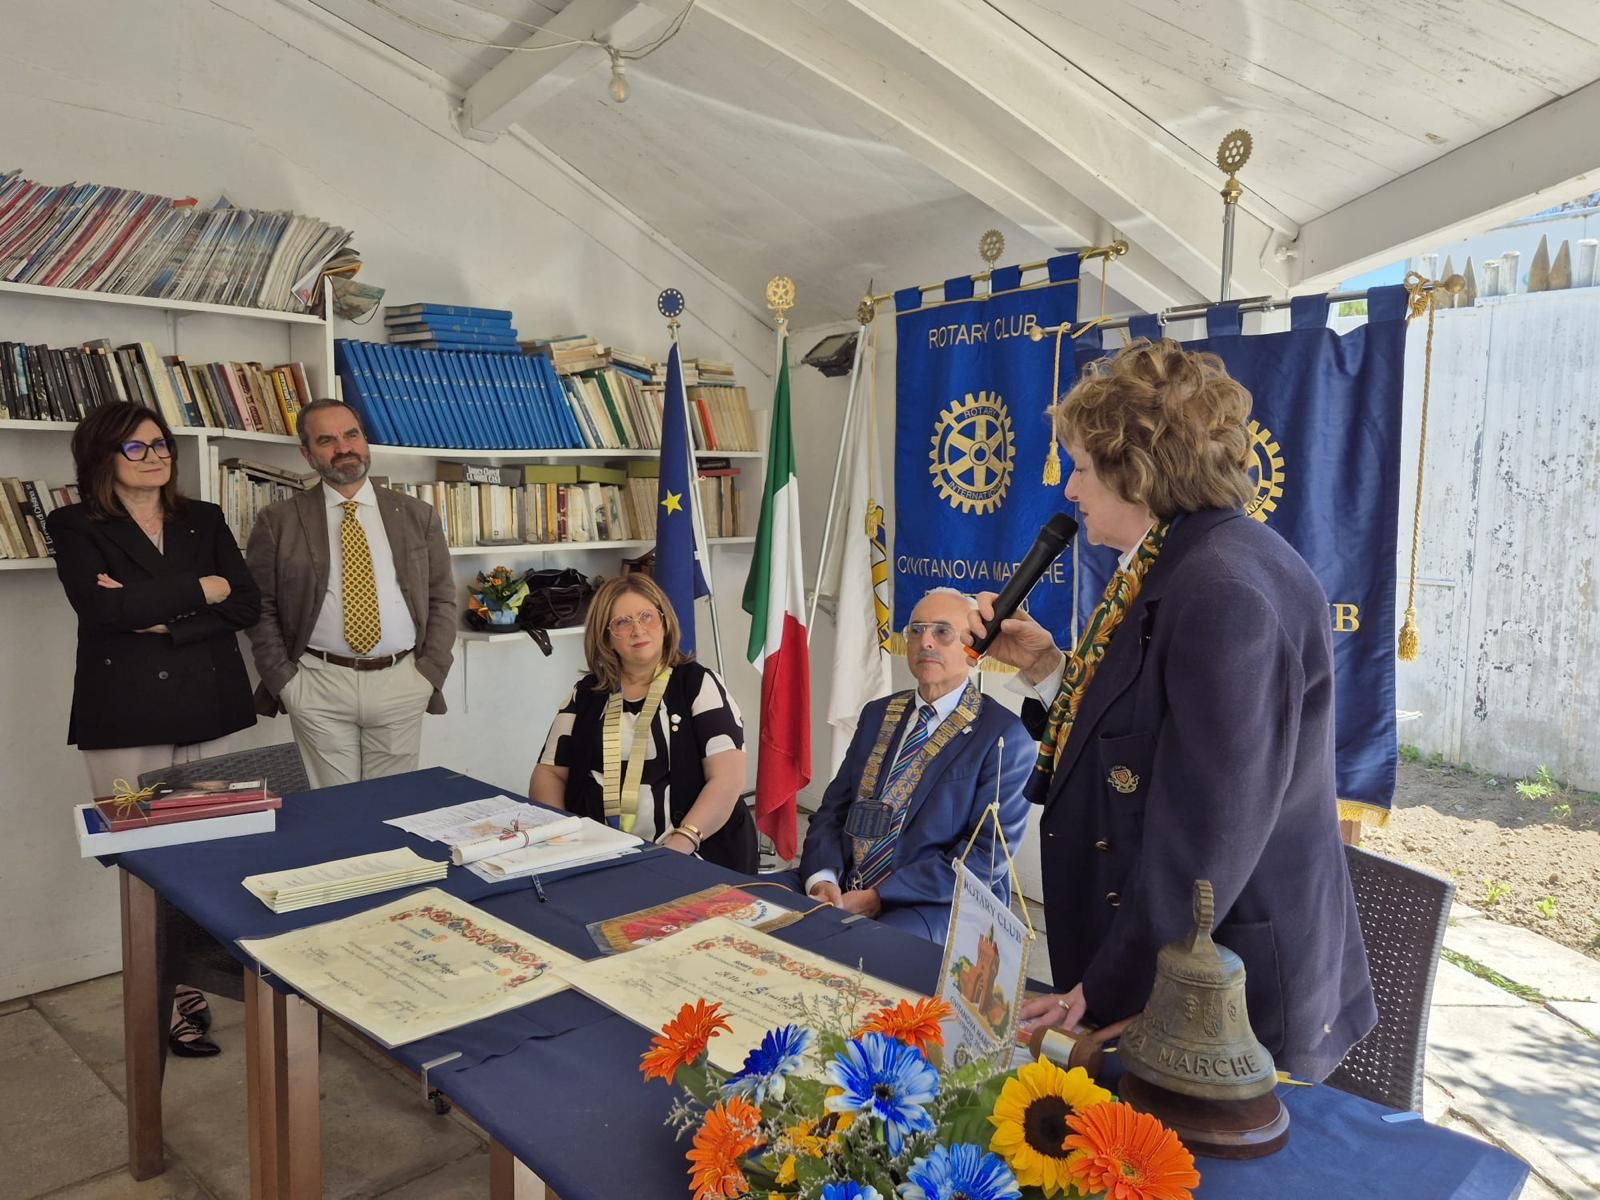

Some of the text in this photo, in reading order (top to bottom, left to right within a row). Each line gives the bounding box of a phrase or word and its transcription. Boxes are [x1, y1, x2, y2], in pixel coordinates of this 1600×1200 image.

[928, 314, 1037, 350] ROTARY CLUB
[963, 407, 997, 419] ROTARY
[897, 555, 1066, 584] CIVITANOVA MAHE
[963, 879, 995, 917] ROTARY
[1157, 1047, 1261, 1078] MARCHE
